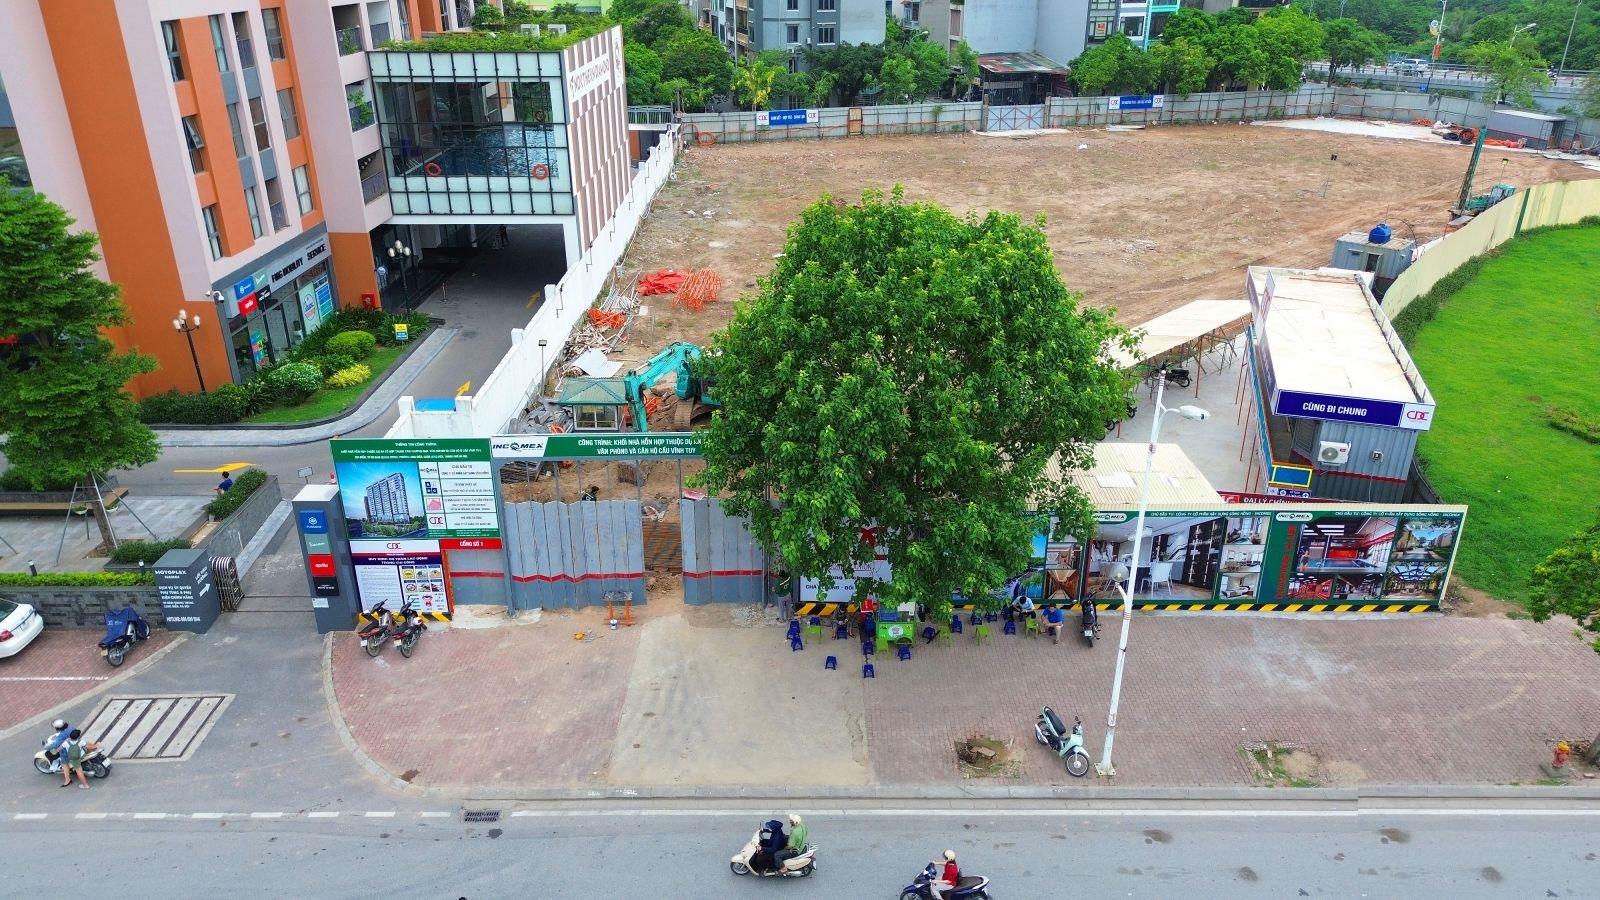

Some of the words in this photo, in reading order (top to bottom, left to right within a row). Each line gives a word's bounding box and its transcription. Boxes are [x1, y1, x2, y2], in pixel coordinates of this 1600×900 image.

[1302, 402, 1326, 412] CÙNG
[1327, 405, 1336, 413] ĐI
[1338, 406, 1368, 416] CHUNG
[1406, 411, 1430, 420] CDC
[492, 442, 544, 450] INCOMEX
